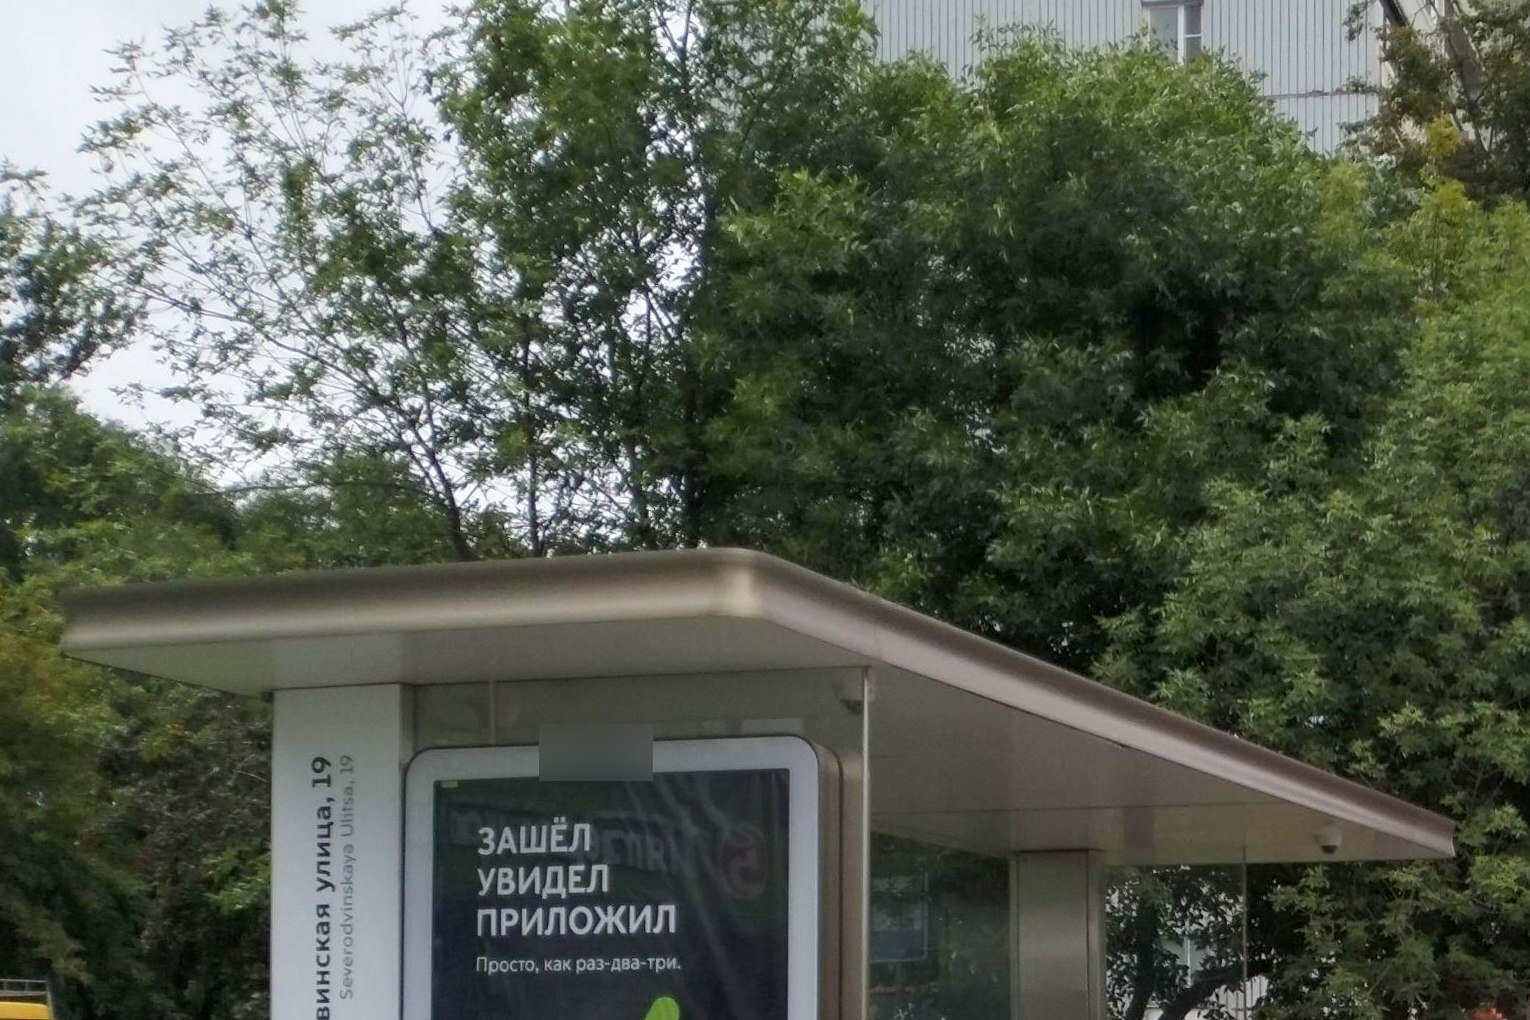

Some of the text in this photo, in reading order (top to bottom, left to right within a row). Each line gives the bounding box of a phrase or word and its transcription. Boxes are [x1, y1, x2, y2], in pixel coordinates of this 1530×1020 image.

[311, 756, 332, 788] 19
[315, 796, 335, 893] улица,
[477, 817, 591, 856] ЗАШЁЛ
[339, 754, 357, 1000] Severodvinskaya Ulitsa, 19
[477, 864, 609, 899] УВИДЕЛ
[476, 904, 677, 936] ПРИЛОЖИЛ
[476, 956, 681, 976] Просто, как раз-два-три.
